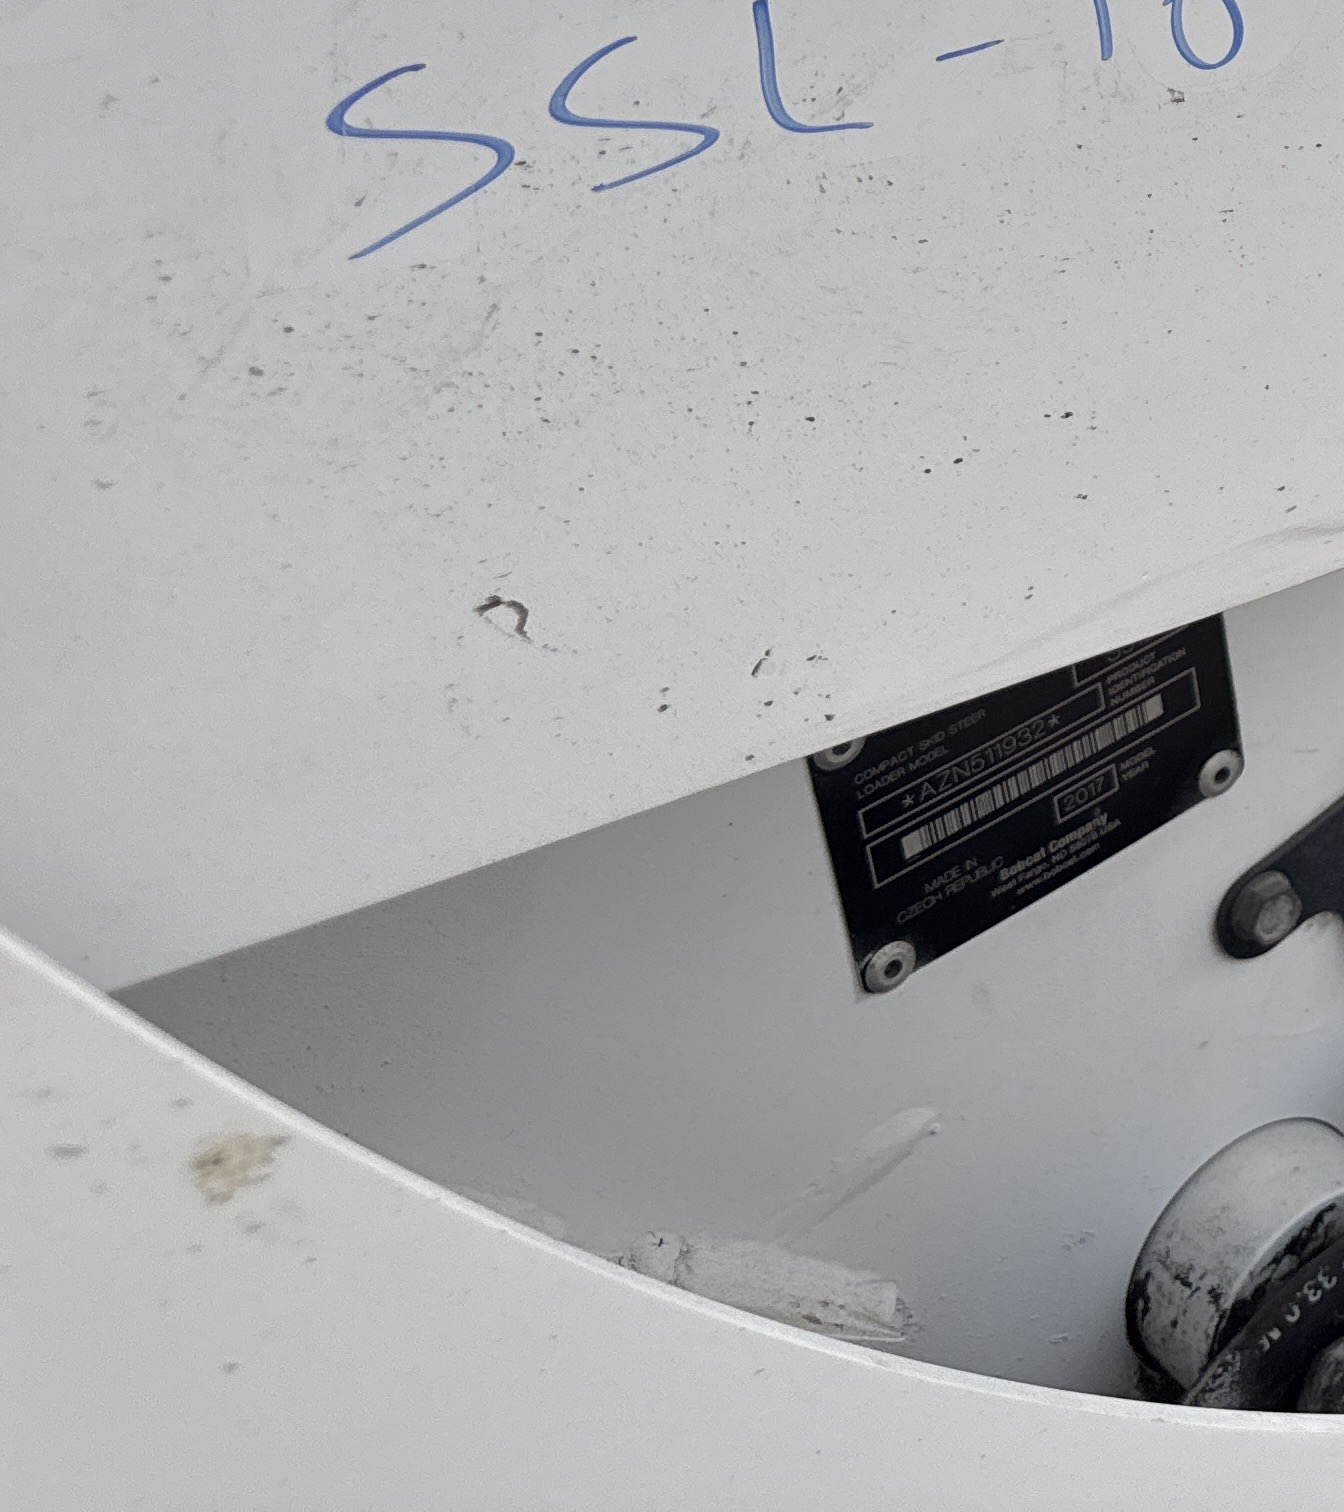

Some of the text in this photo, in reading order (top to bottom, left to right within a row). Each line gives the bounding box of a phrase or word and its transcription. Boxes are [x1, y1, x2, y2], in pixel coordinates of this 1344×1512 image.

[1106, 650, 1156, 685] PRODUCT
[1108, 646, 1187, 695] IDENTIFICATION
[1110, 676, 1156, 706] NUMBER
[854, 708, 987, 786] COMPACT SKID STEER
[1119, 745, 1157, 771] MODEL
[857, 745, 951, 800] LOADER MODEL
[1121, 759, 1150, 782] YEAR
[1063, 776, 1106, 811] 2017
[1100, 817, 1123, 838] USA
[1001, 812, 1108, 881] Bobcat Company
[897, 855, 1004, 923] CZECH REPUBLIC
[924, 856, 979, 893] MADE IN
